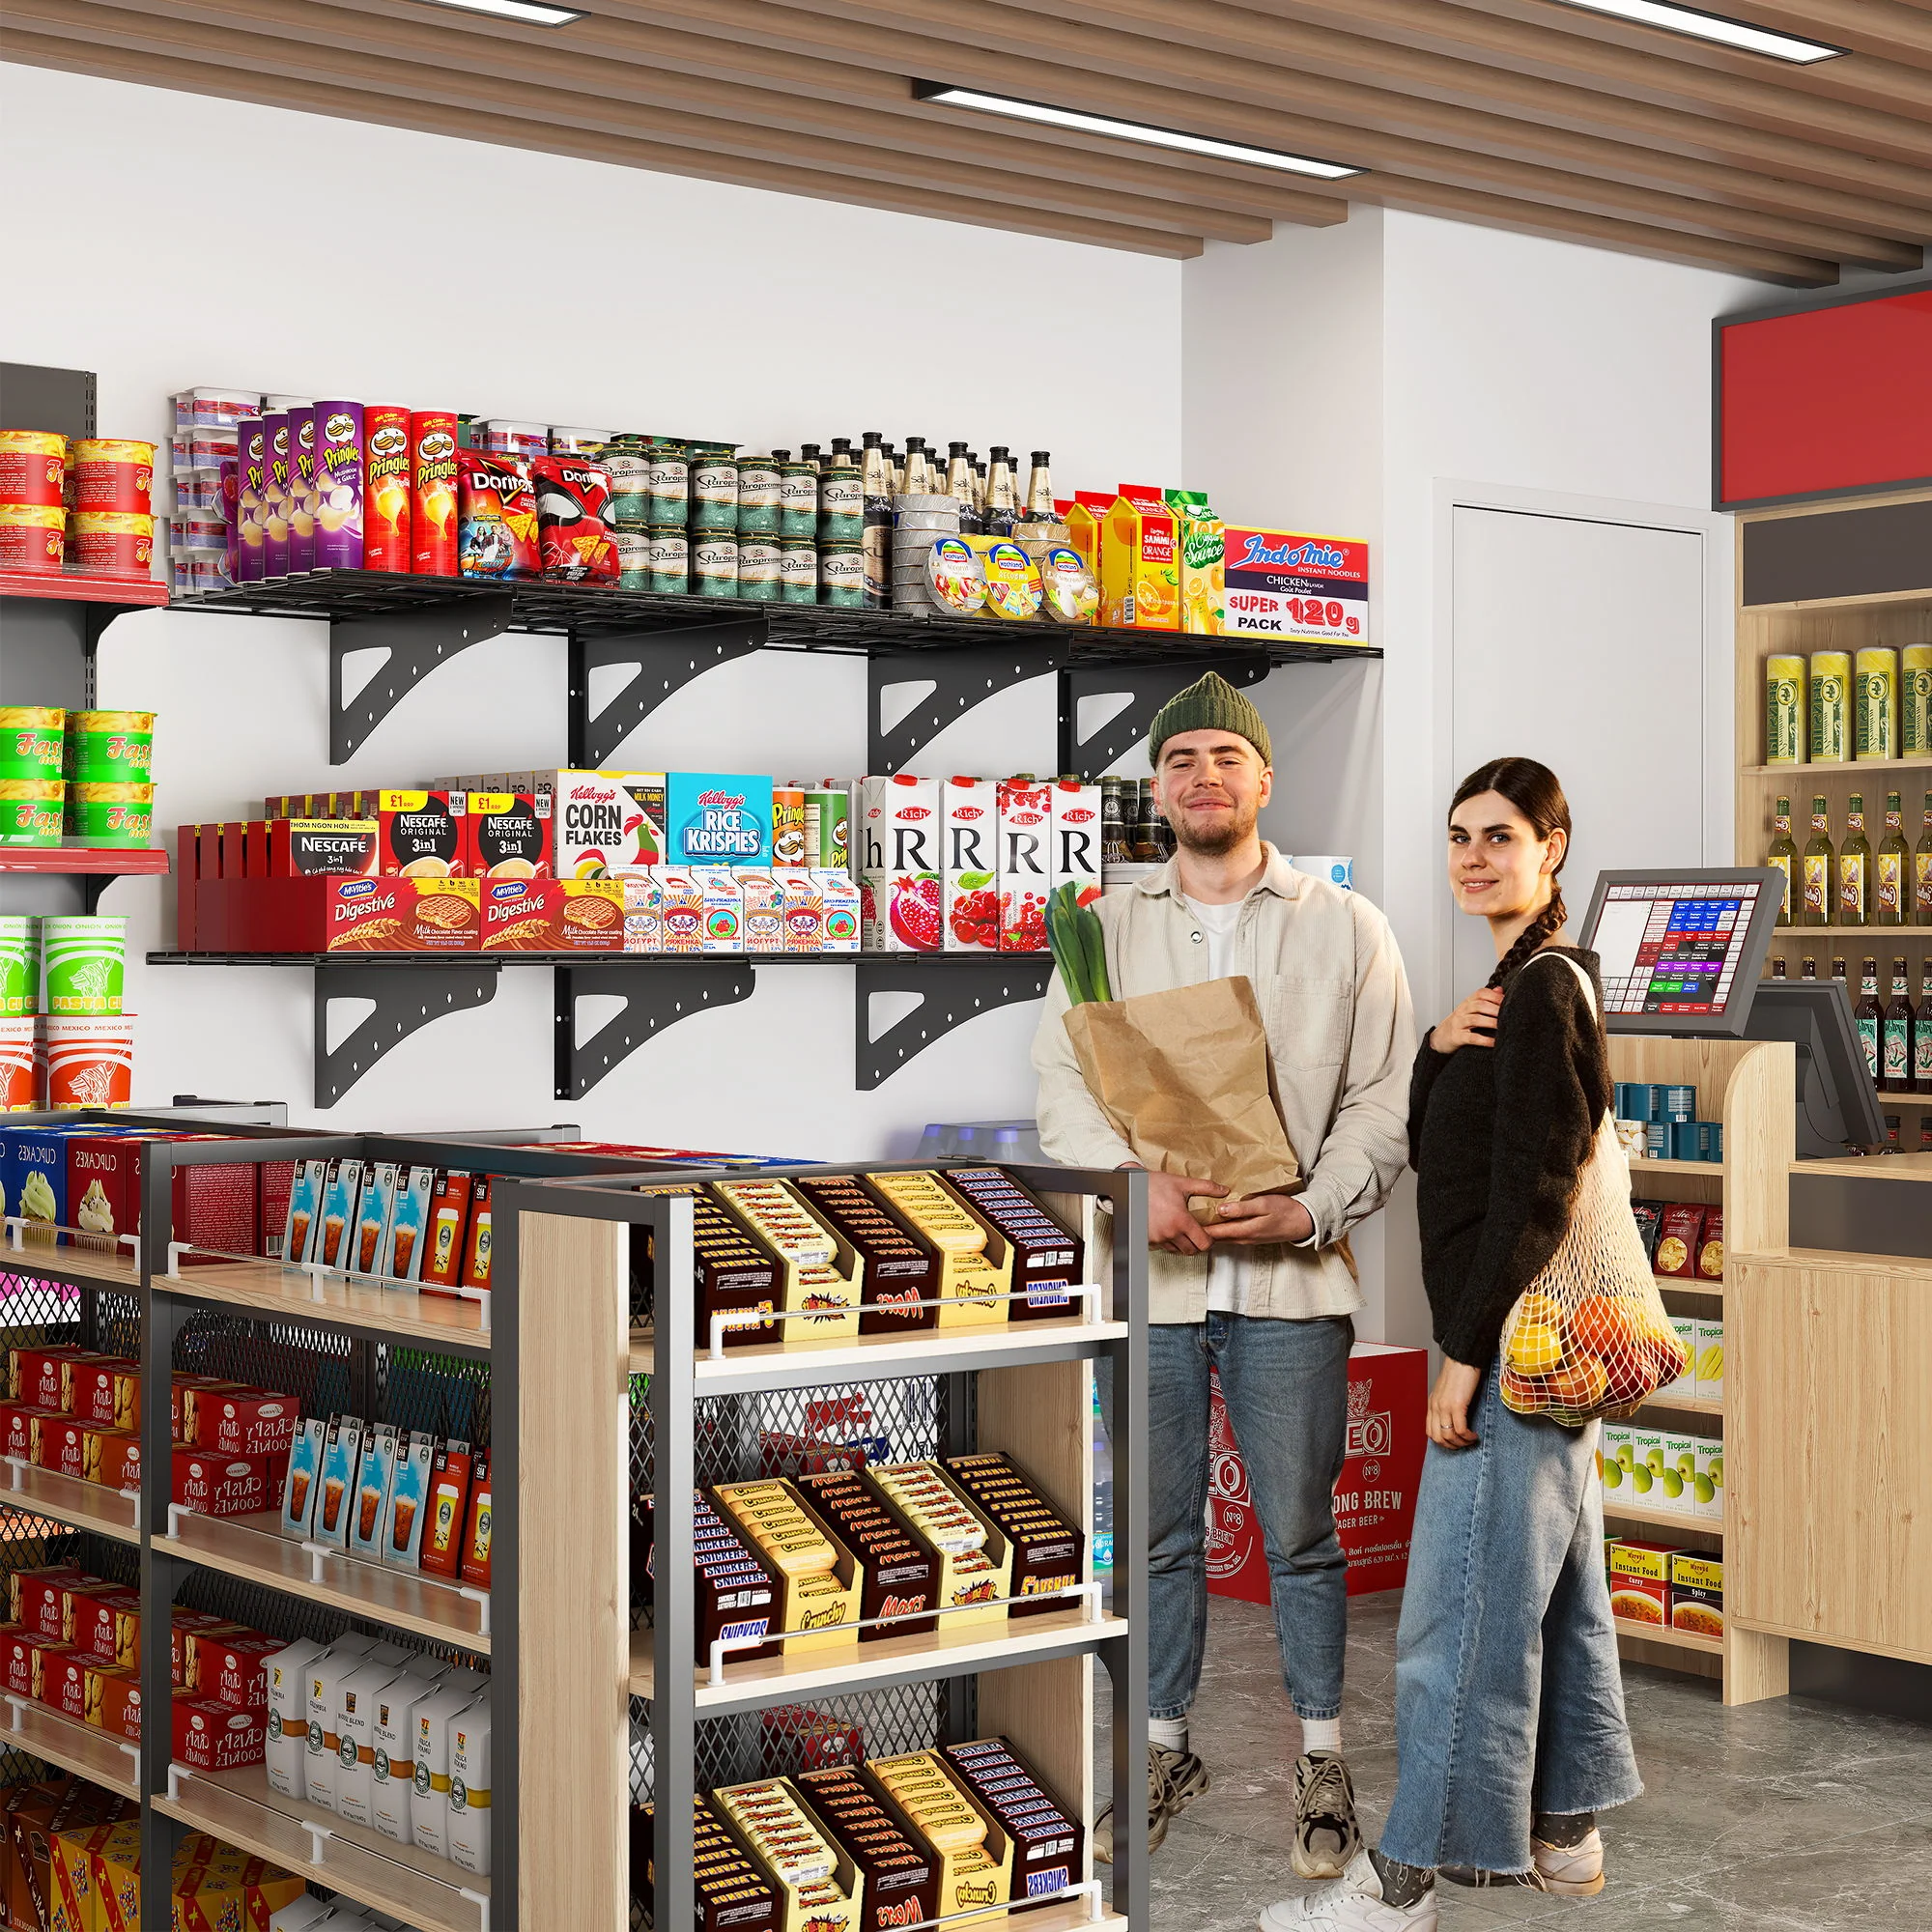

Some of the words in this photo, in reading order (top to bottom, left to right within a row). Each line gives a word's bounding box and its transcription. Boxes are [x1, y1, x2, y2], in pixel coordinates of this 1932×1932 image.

[324, 441, 359, 472] Pringles
[369, 452, 410, 485] Pringles
[417, 458, 458, 490] Pringles
[1143, 546, 1172, 557] ORANGE
[1183, 543, 1224, 565] Source
[1297, 566, 1327, 576] INSTANT
[1328, 569, 1361, 579] NOODLES
[1266, 576, 1308, 587] CHICKEN
[1229, 595, 1279, 613] SUPER
[1286, 597, 1344, 628] 120
[1237, 616, 1282, 632] PACK
[570, 784, 616, 804] Kellogg's
[646, 793, 665, 803] MONEY
[698, 790, 747, 810] Kellogg's
[450, 797, 465, 807] NEW
[536, 798, 550, 809] NEW
[566, 805, 621, 829] CORN
[900, 808, 929, 819] Rich
[954, 807, 982, 818] Rich
[1014, 812, 1041, 825] Rich
[1065, 810, 1093, 822] Rich
[705, 810, 742, 832] RICE
[488, 829, 532, 838] ORIGINAL
[566, 831, 622, 846] FLAKES
[412, 838, 437, 853] 3in1
[498, 839, 523, 854] 3in1
[687, 829, 760, 854] KRISPIES
[327, 855, 344, 865] 3in1
[334, 893, 395, 923] Digestive
[488, 894, 545, 923] Digestive
[747, 937, 780, 946] ЙОГУРТ
[53, 996, 107, 1010] PASTA
[1606, 1432, 1631, 1442] Tropical
[1636, 1436, 1661, 1447] Tropical
[1666, 1440, 1692, 1452] Tropical
[1364, 1491, 1403, 1511] BREW
[1335, 1517, 1357, 1529] AGER
[1359, 1515, 1378, 1527] BEER
[704, 1561, 758, 1577] SNICKERS
[1615, 1562, 1641, 1575] Instant
[1642, 1566, 1659, 1577] Food
[714, 1573, 768, 1589] SNICKERS
[1629, 1577, 1644, 1586] Curry
[1677, 1573, 1704, 1585] Instant
[1705, 1578, 1721, 1589] Food
[1691, 1589, 1707, 1599] Spicy
[876, 1594, 926, 1630] Mars
